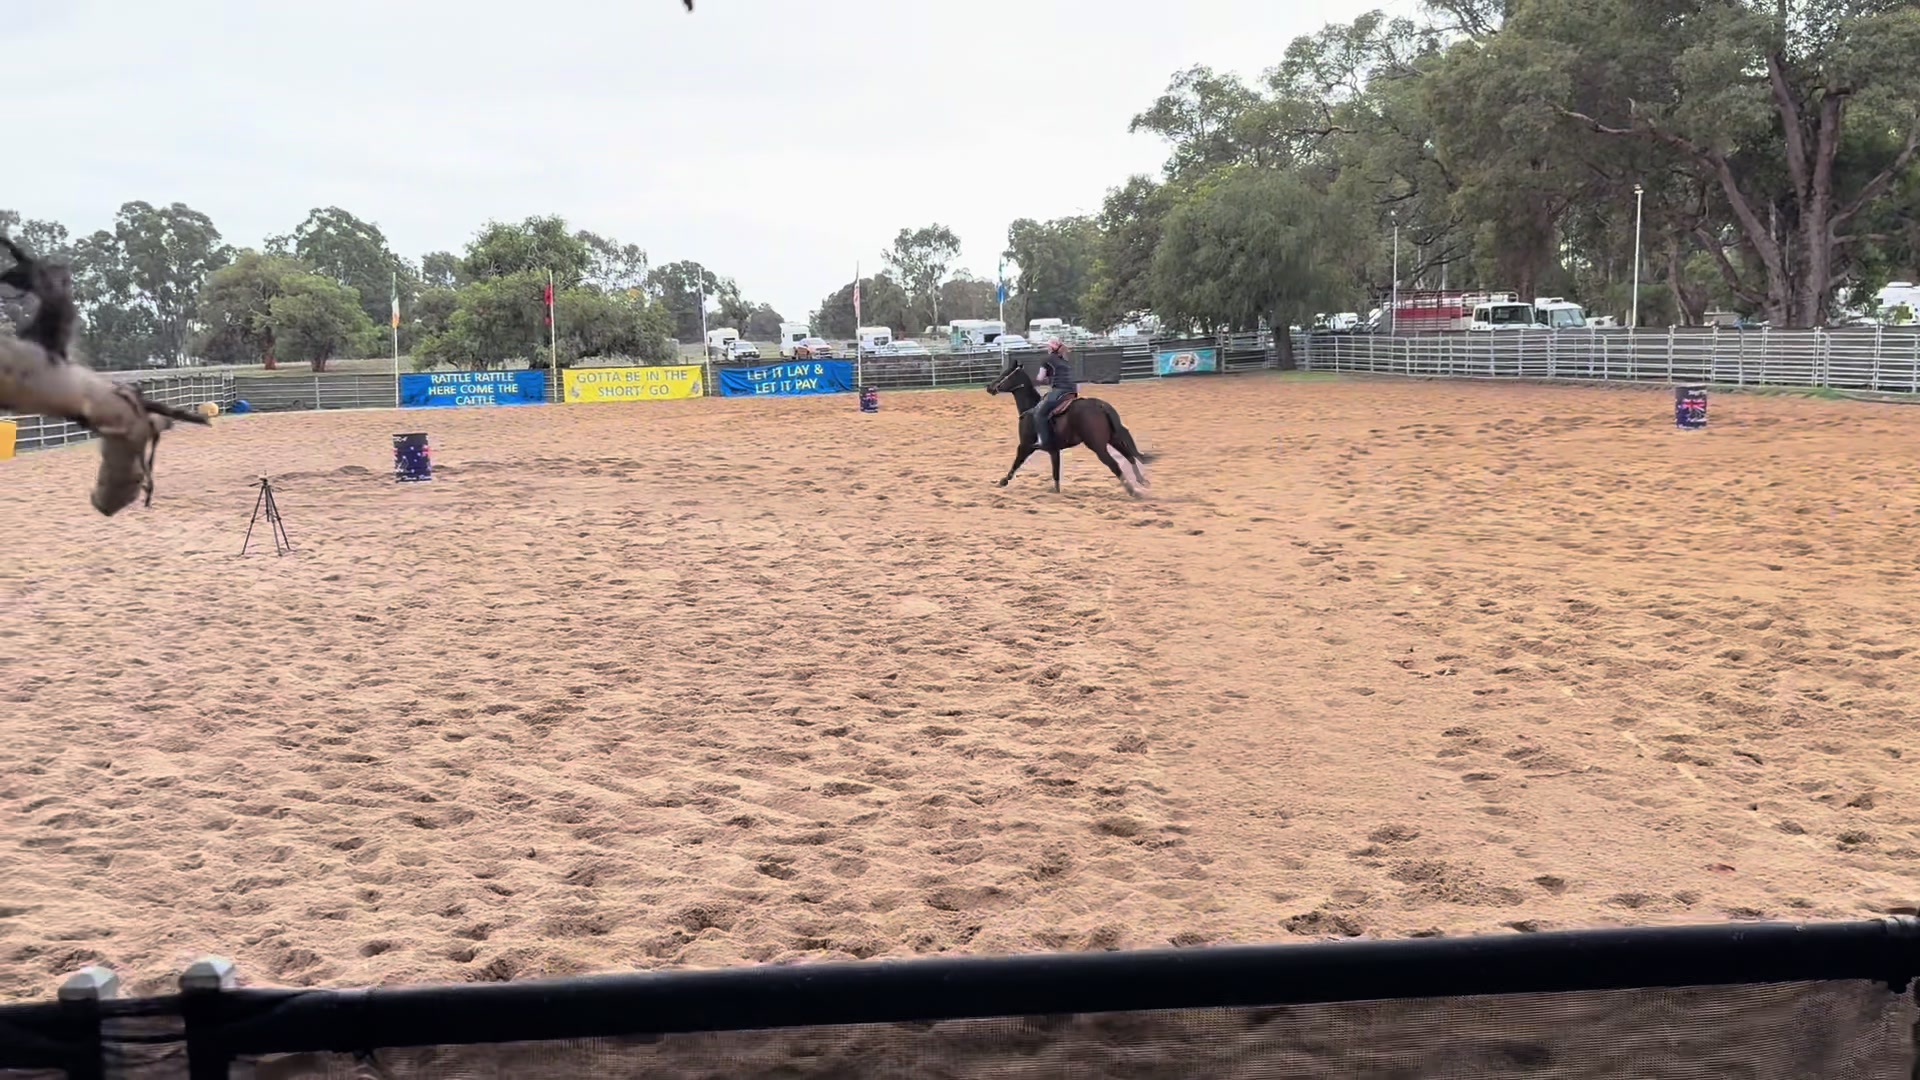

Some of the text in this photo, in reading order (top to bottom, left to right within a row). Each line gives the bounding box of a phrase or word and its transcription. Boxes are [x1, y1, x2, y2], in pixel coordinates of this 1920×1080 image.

[431, 372, 514, 384] RATTLE RATTLE
[576, 369, 688, 383] GOTTA BE IN THE
[747, 363, 824, 381] LET IT LAY &
[428, 383, 518, 395] HERE COME THE
[649, 384, 669, 396] GO
[755, 378, 818, 394] LET IT PAY
[455, 395, 495, 405] CATTLE
